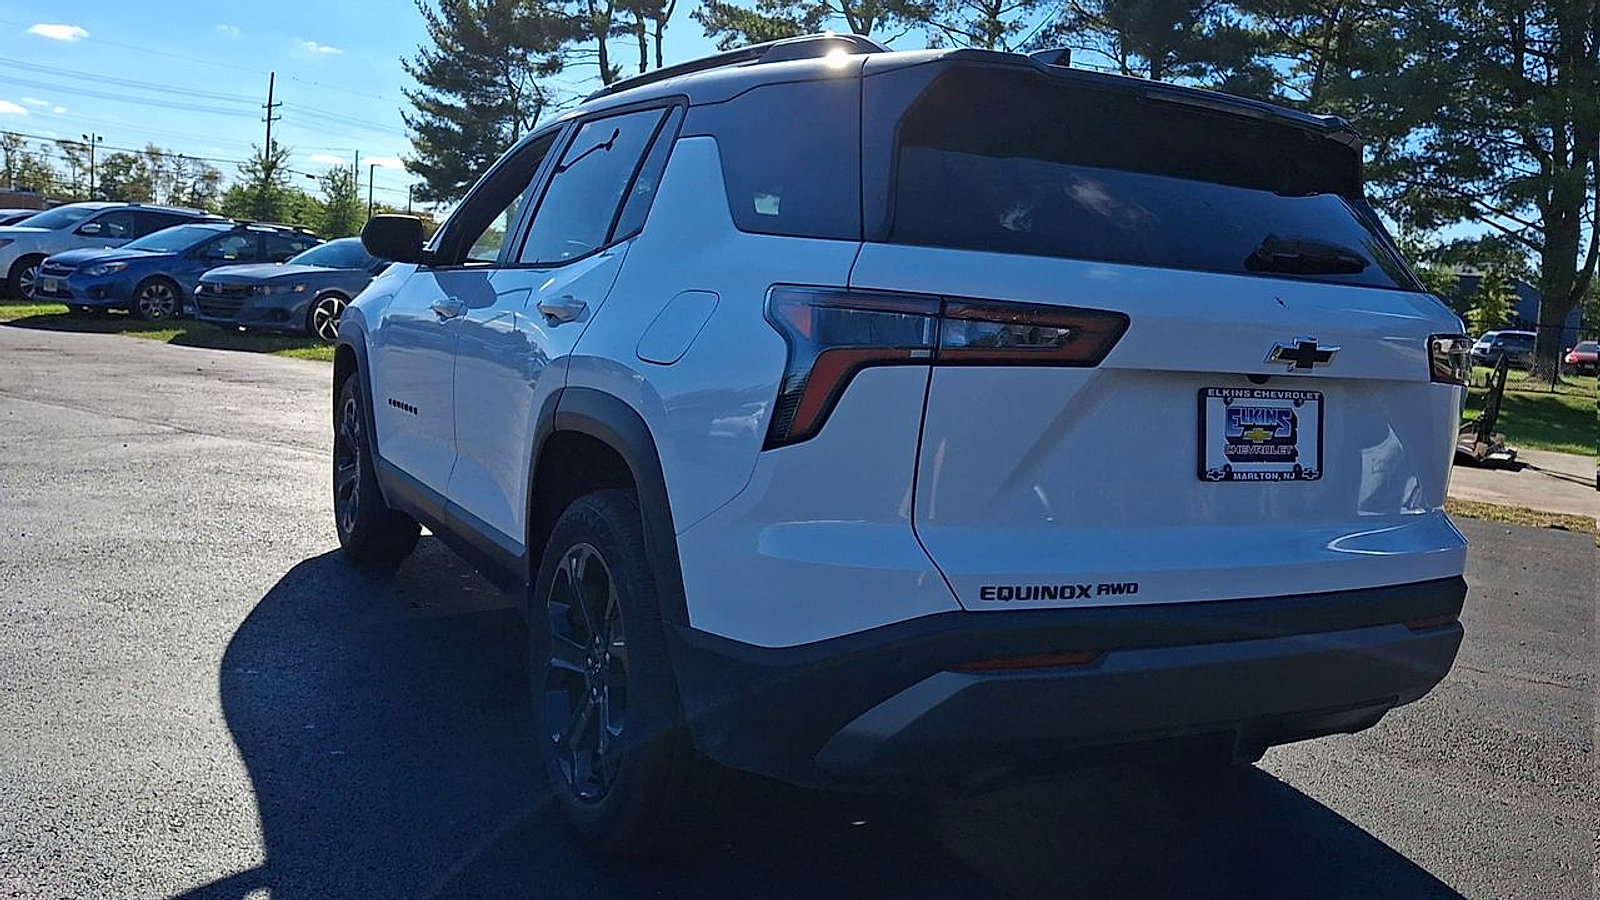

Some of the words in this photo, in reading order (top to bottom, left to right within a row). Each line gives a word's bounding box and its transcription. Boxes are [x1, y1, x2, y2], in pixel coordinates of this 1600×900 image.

[1208, 389, 1251, 398] ELKINS
[1253, 391, 1320, 400] CHEVROLET
[1226, 407, 1293, 438] ELKINS
[1226, 445, 1293, 454] CHEVROLET
[1233, 472, 1282, 481] MARLTON,
[1284, 472, 1296, 480] NJ
[980, 585, 1092, 602] EQUINOX
[1097, 582, 1139, 596] AWD
